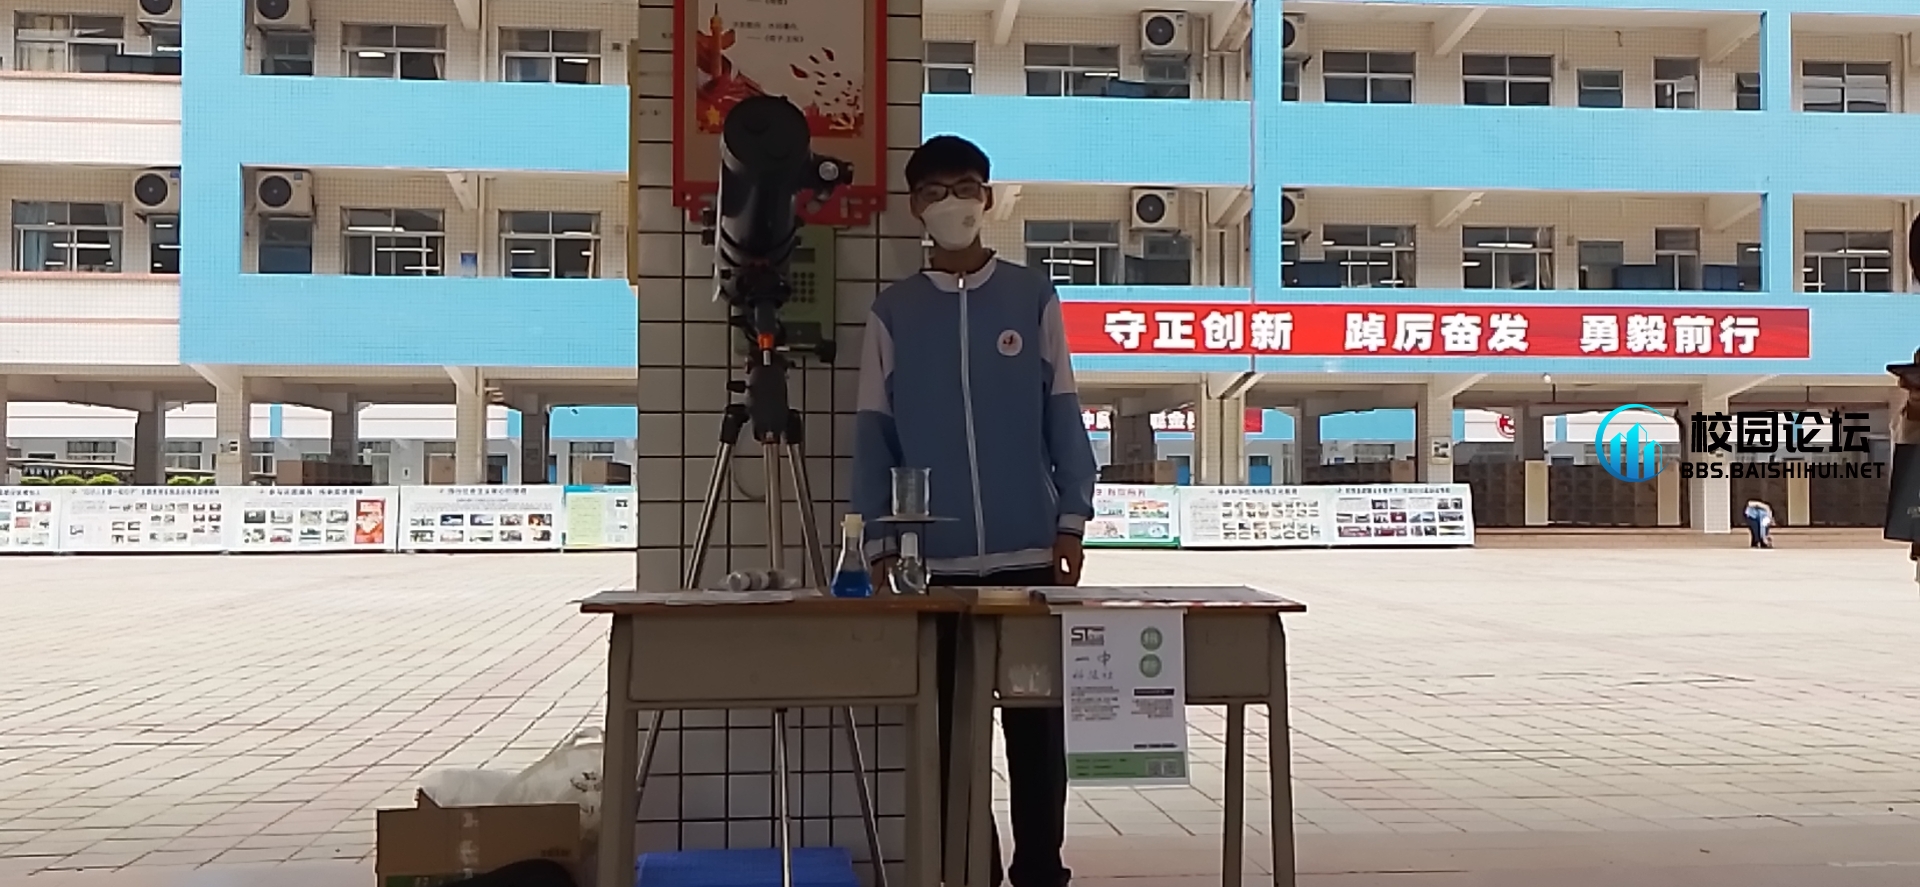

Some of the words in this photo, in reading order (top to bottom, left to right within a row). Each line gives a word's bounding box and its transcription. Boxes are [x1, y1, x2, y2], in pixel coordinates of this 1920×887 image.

[1104, 309, 1293, 350] 守正创新
[1343, 312, 1530, 352] 踔厉奋发
[1579, 313, 1760, 354] 勇毅前行
